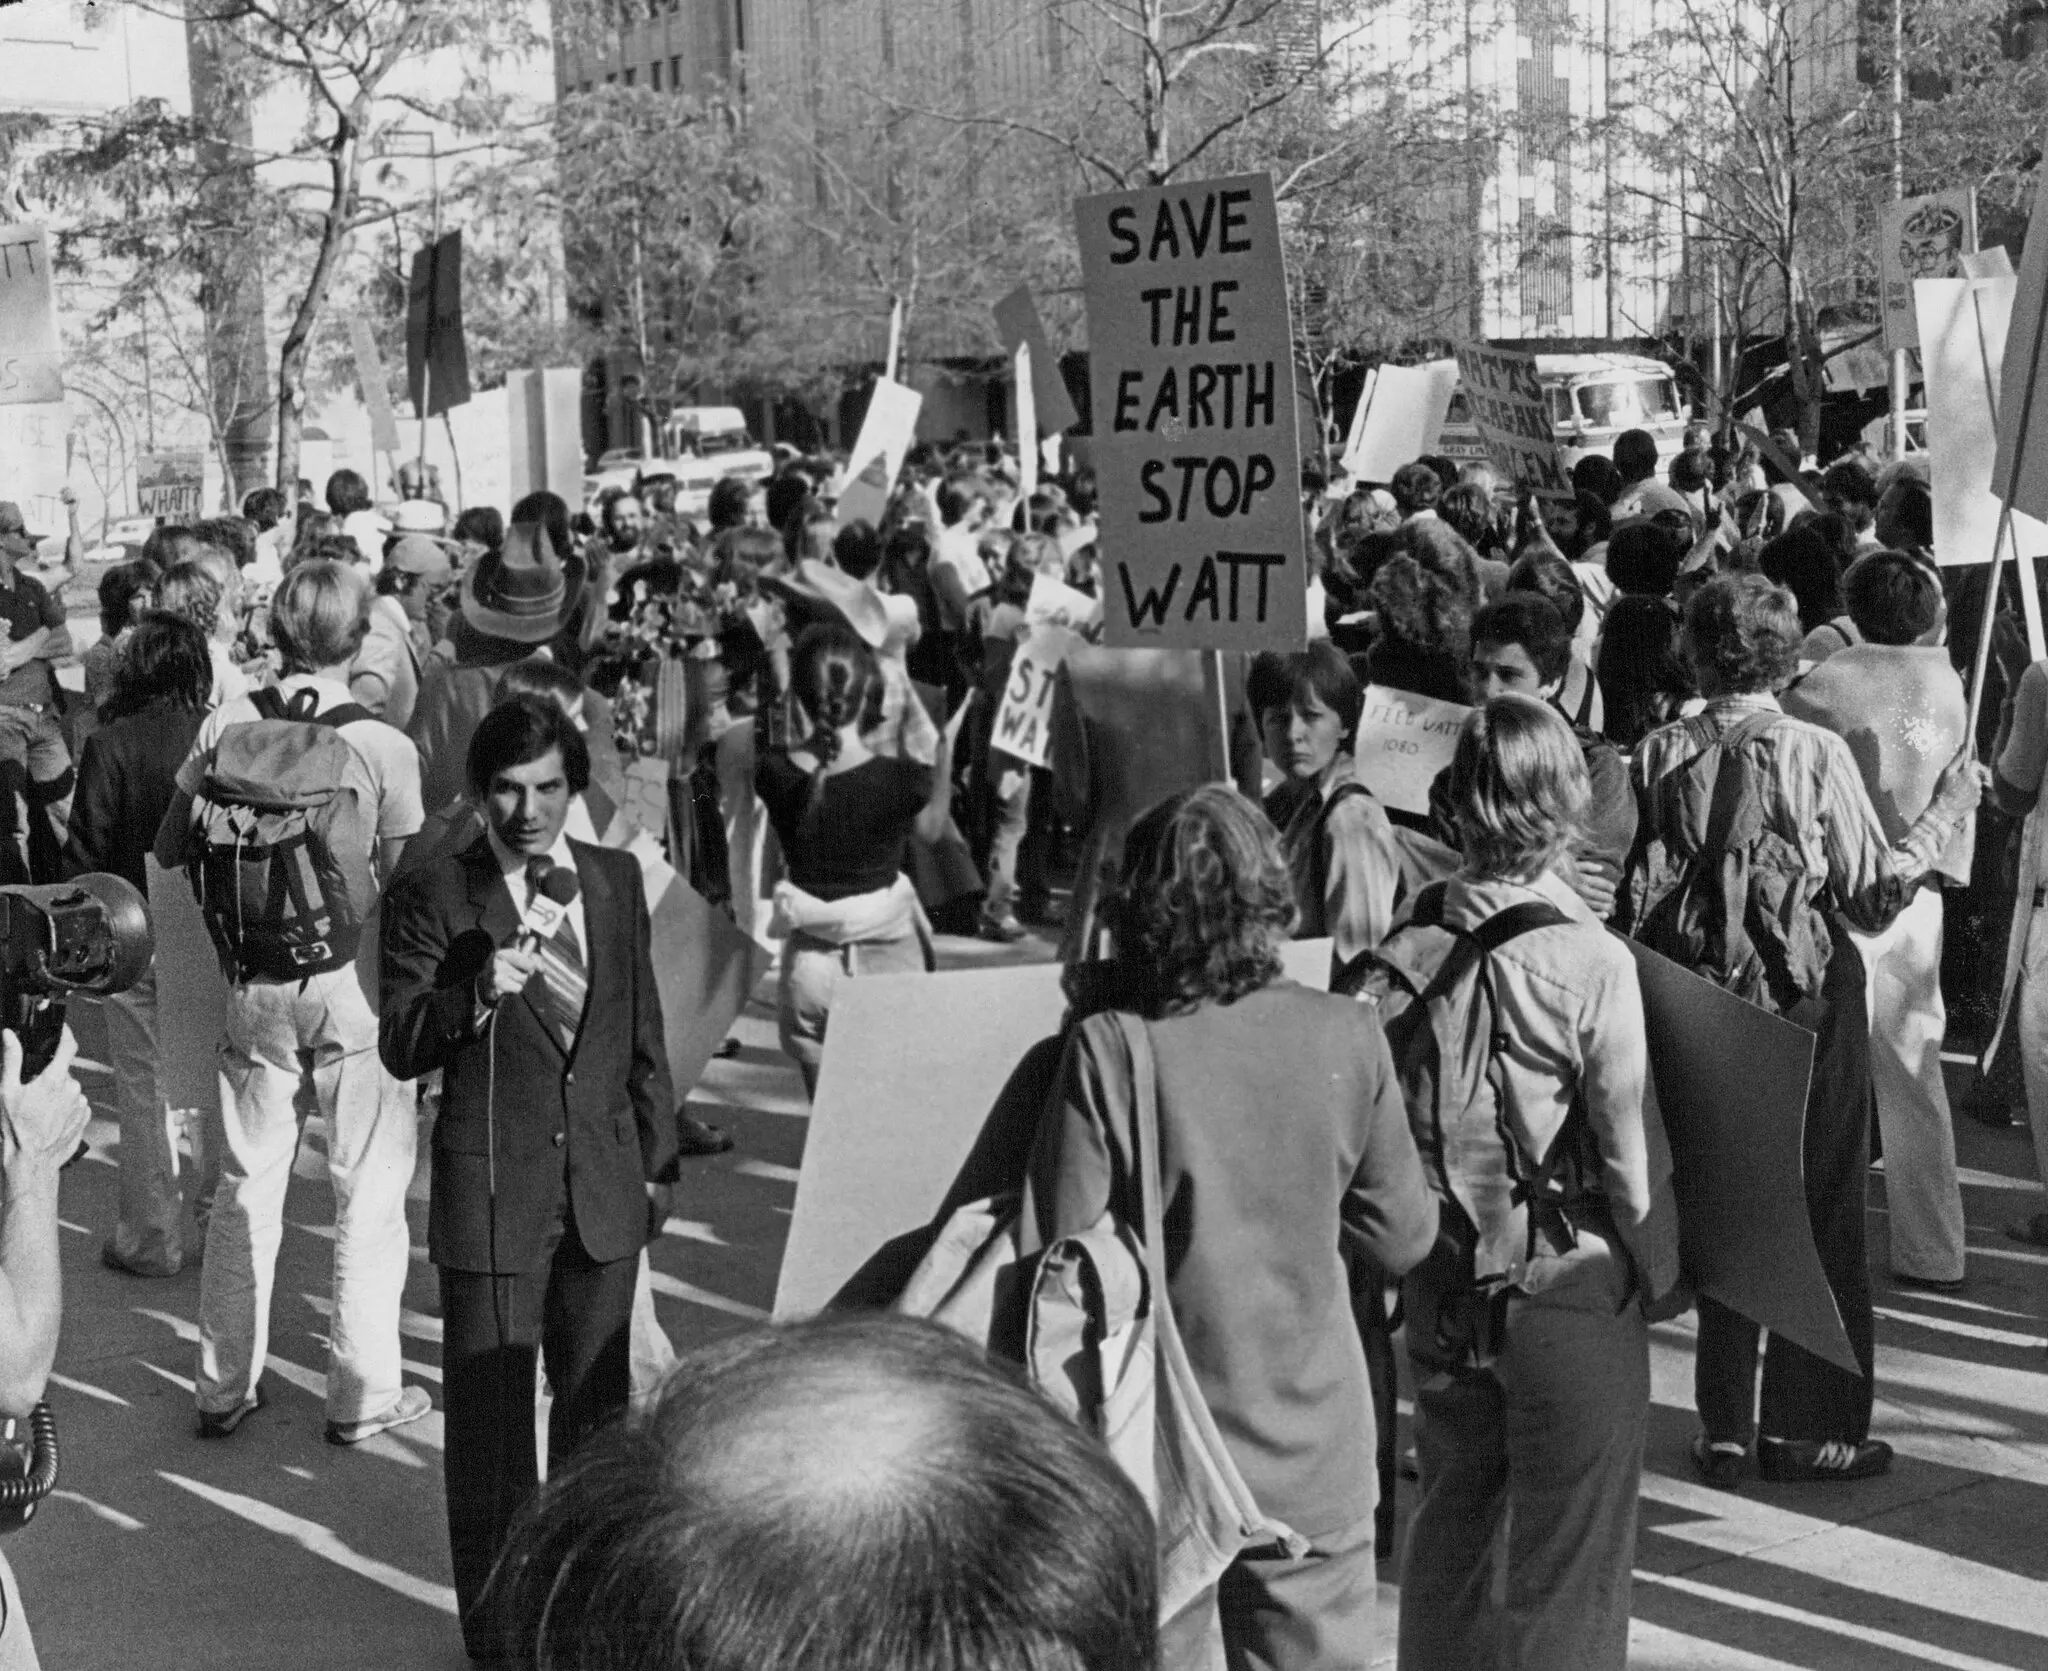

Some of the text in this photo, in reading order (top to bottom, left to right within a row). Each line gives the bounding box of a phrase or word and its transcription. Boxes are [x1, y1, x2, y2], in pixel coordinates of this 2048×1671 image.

[1107, 188, 1252, 265] SAVE
[1140, 279, 1239, 347] THE
[1113, 360, 1275, 433] EARTH
[1138, 452, 1276, 524] STOP
[1117, 550, 1286, 629] WATT
